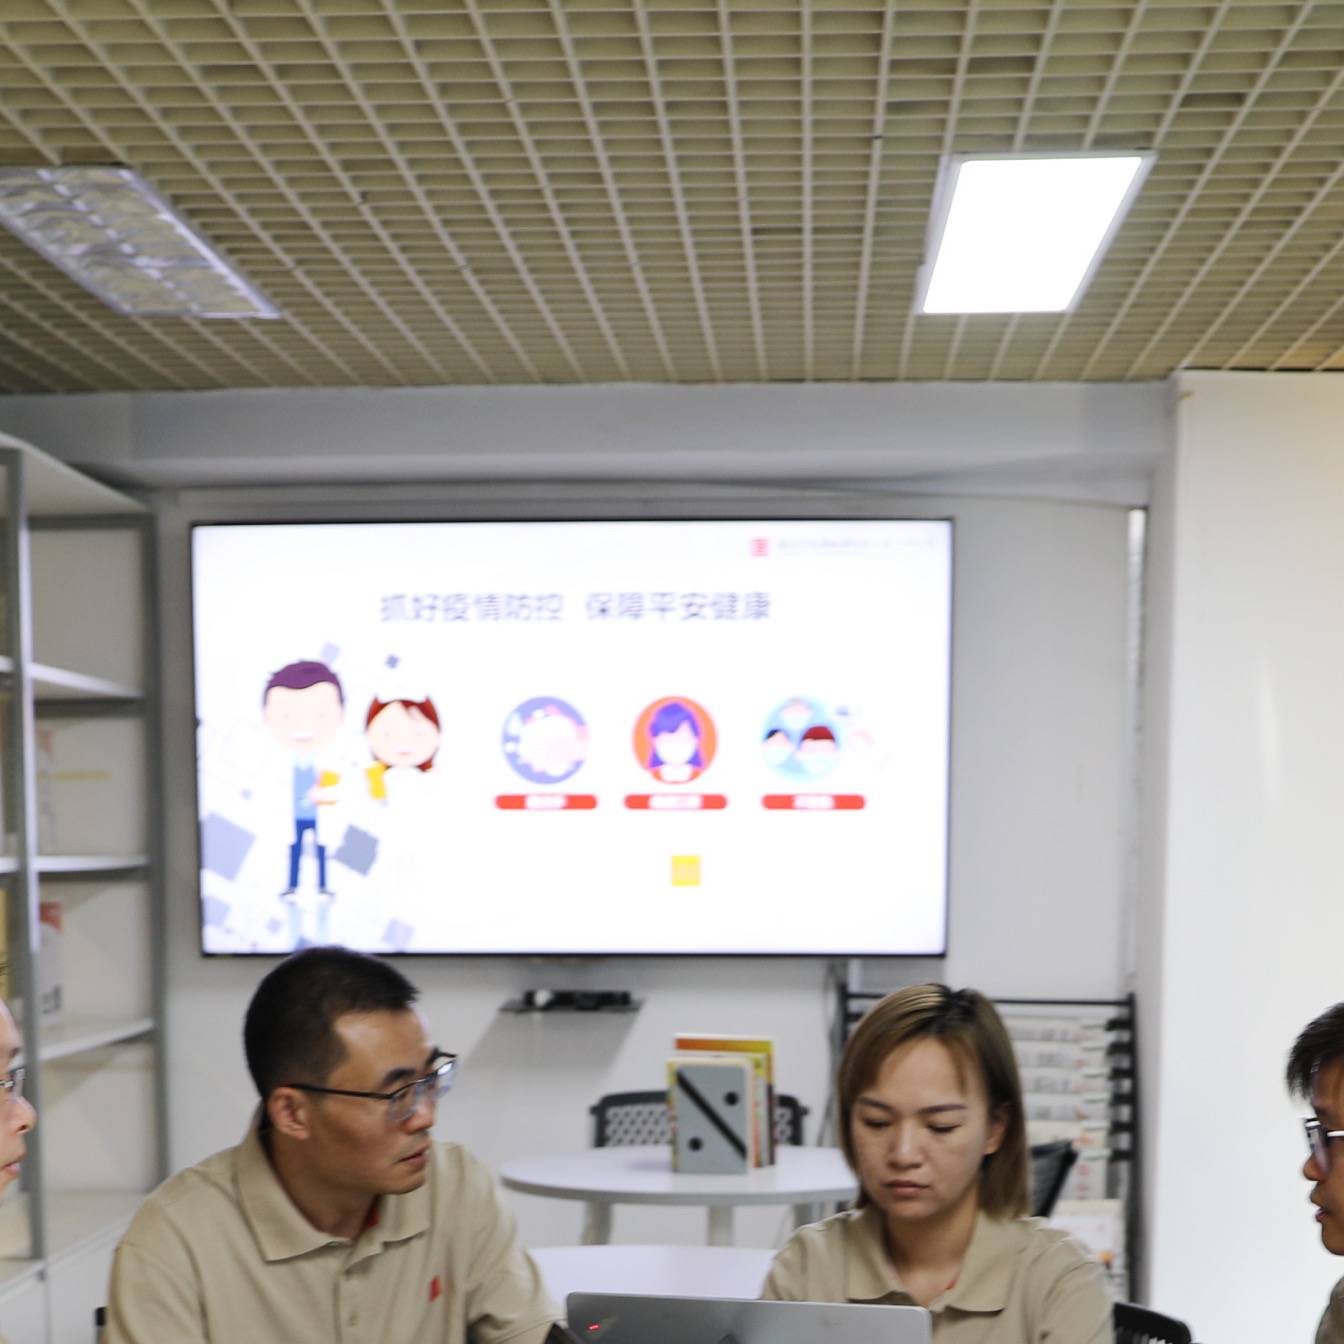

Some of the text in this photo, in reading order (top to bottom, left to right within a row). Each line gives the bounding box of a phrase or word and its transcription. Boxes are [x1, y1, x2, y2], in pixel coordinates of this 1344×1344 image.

[379, 591, 773, 623] 抓好疫情防控 保障平安健康
